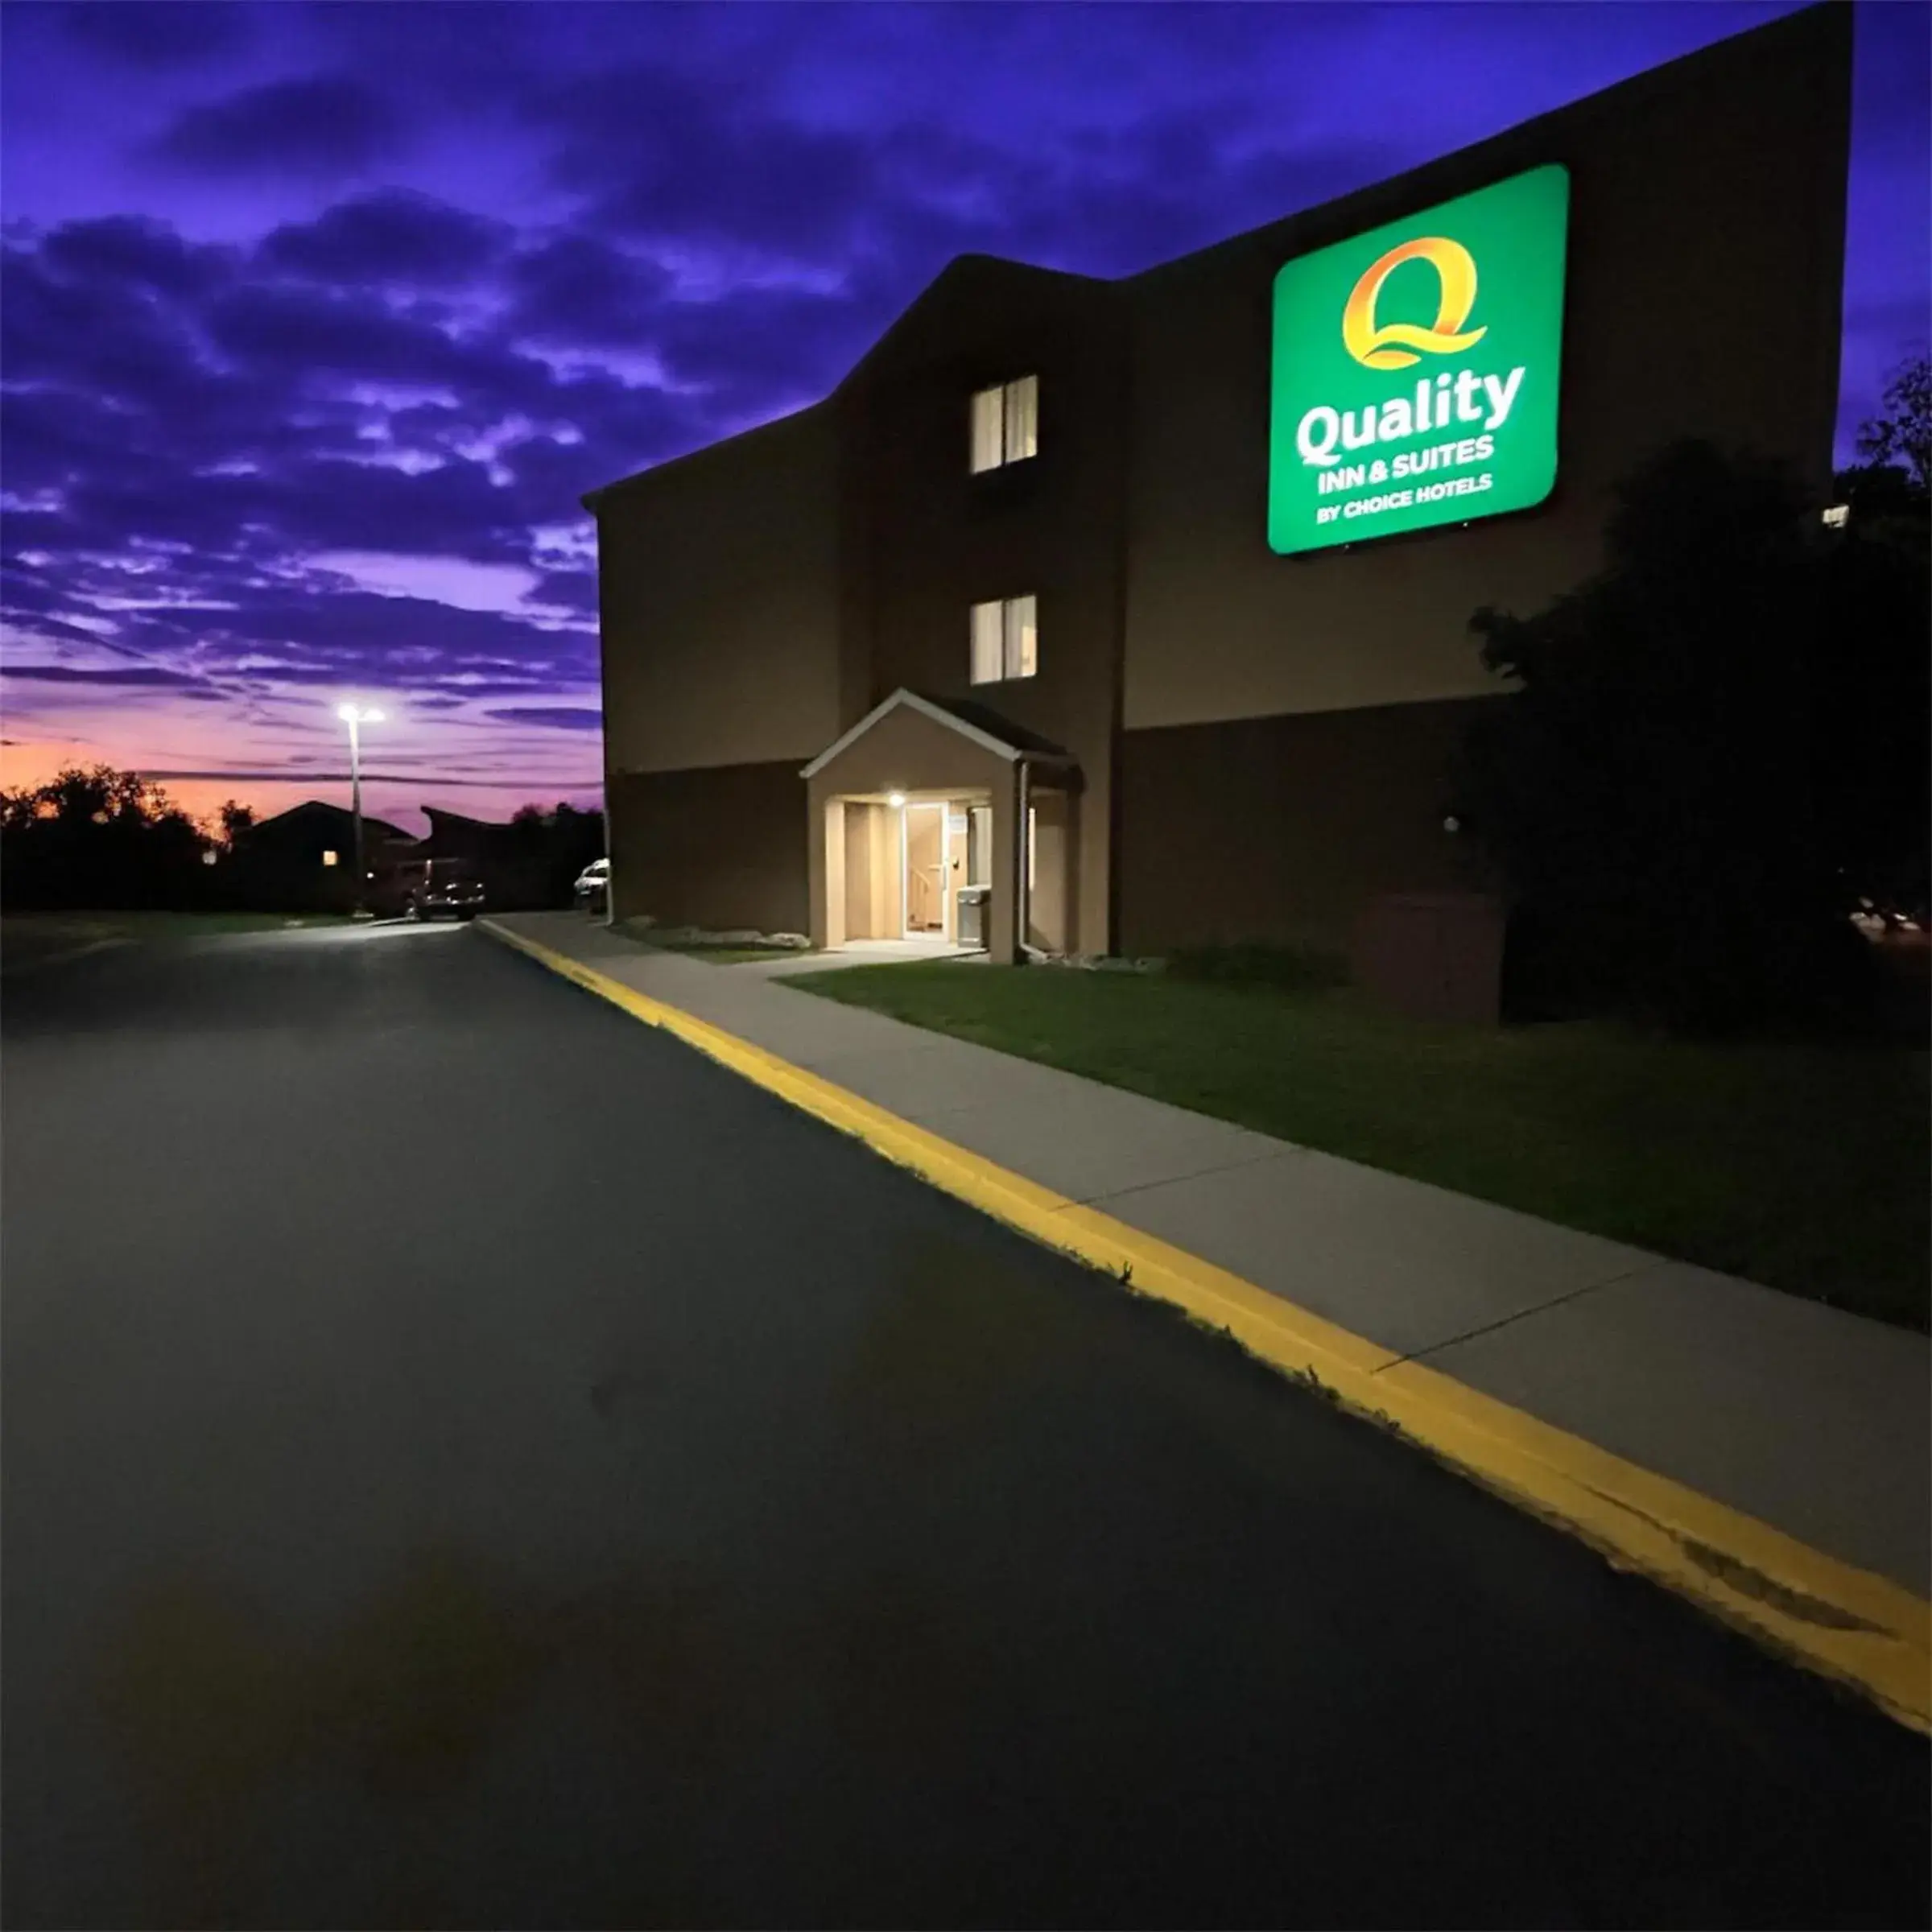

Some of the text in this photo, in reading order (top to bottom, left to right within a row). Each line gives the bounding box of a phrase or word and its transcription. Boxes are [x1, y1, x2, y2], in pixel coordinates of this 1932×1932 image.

[1295, 366, 1526, 466] Quality
[1318, 435, 1494, 494] INN & SUITES
[1316, 473, 1493, 524] BY CHOICE HOTELS
